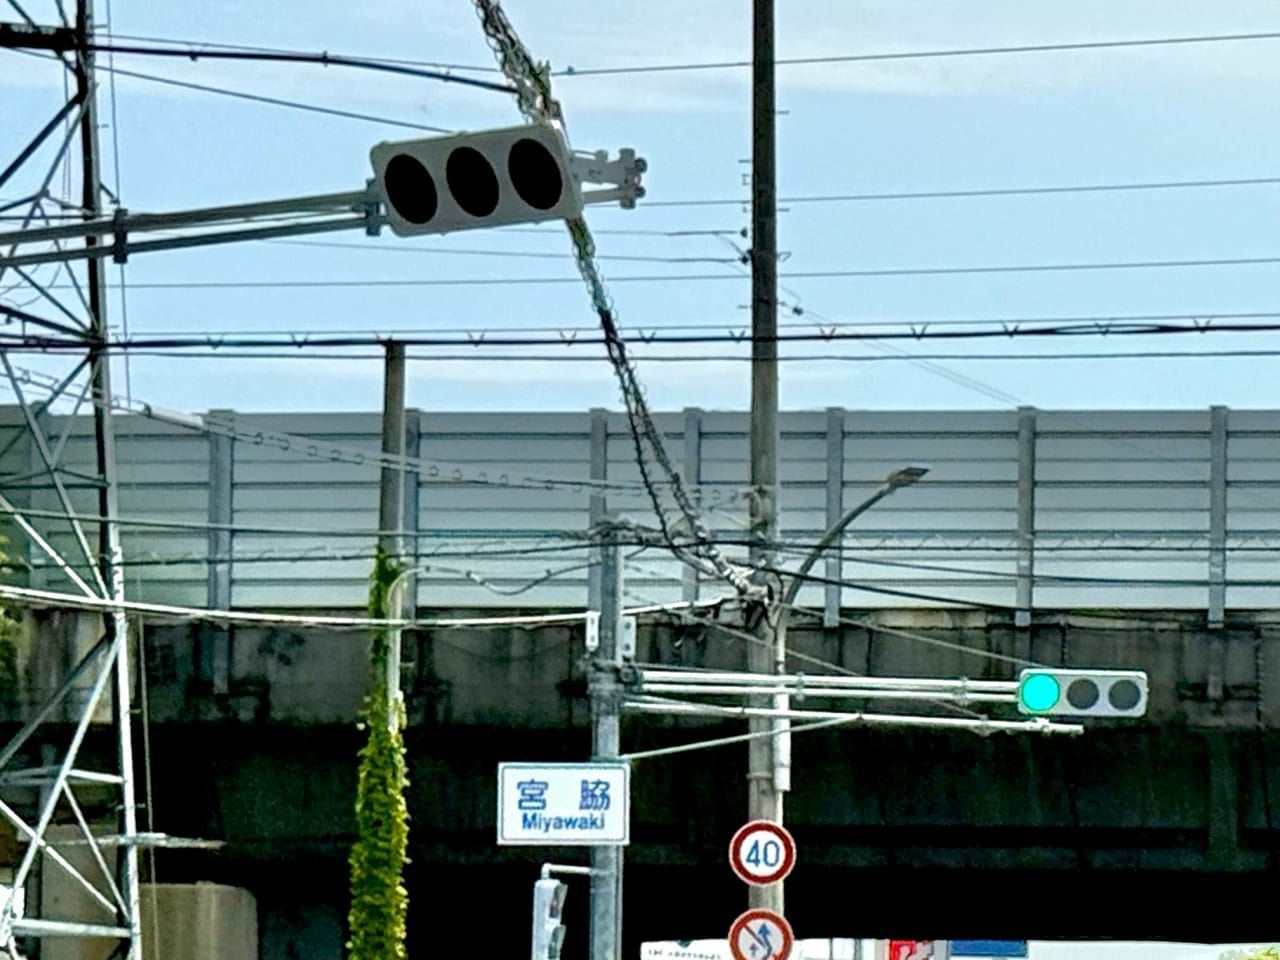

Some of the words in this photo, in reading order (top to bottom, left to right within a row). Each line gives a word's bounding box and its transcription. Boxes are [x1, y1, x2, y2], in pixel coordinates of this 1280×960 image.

[517, 779, 611, 811] 宮脇
[521, 812, 605, 831] Miyawaki
[745, 840, 780, 868] 40
